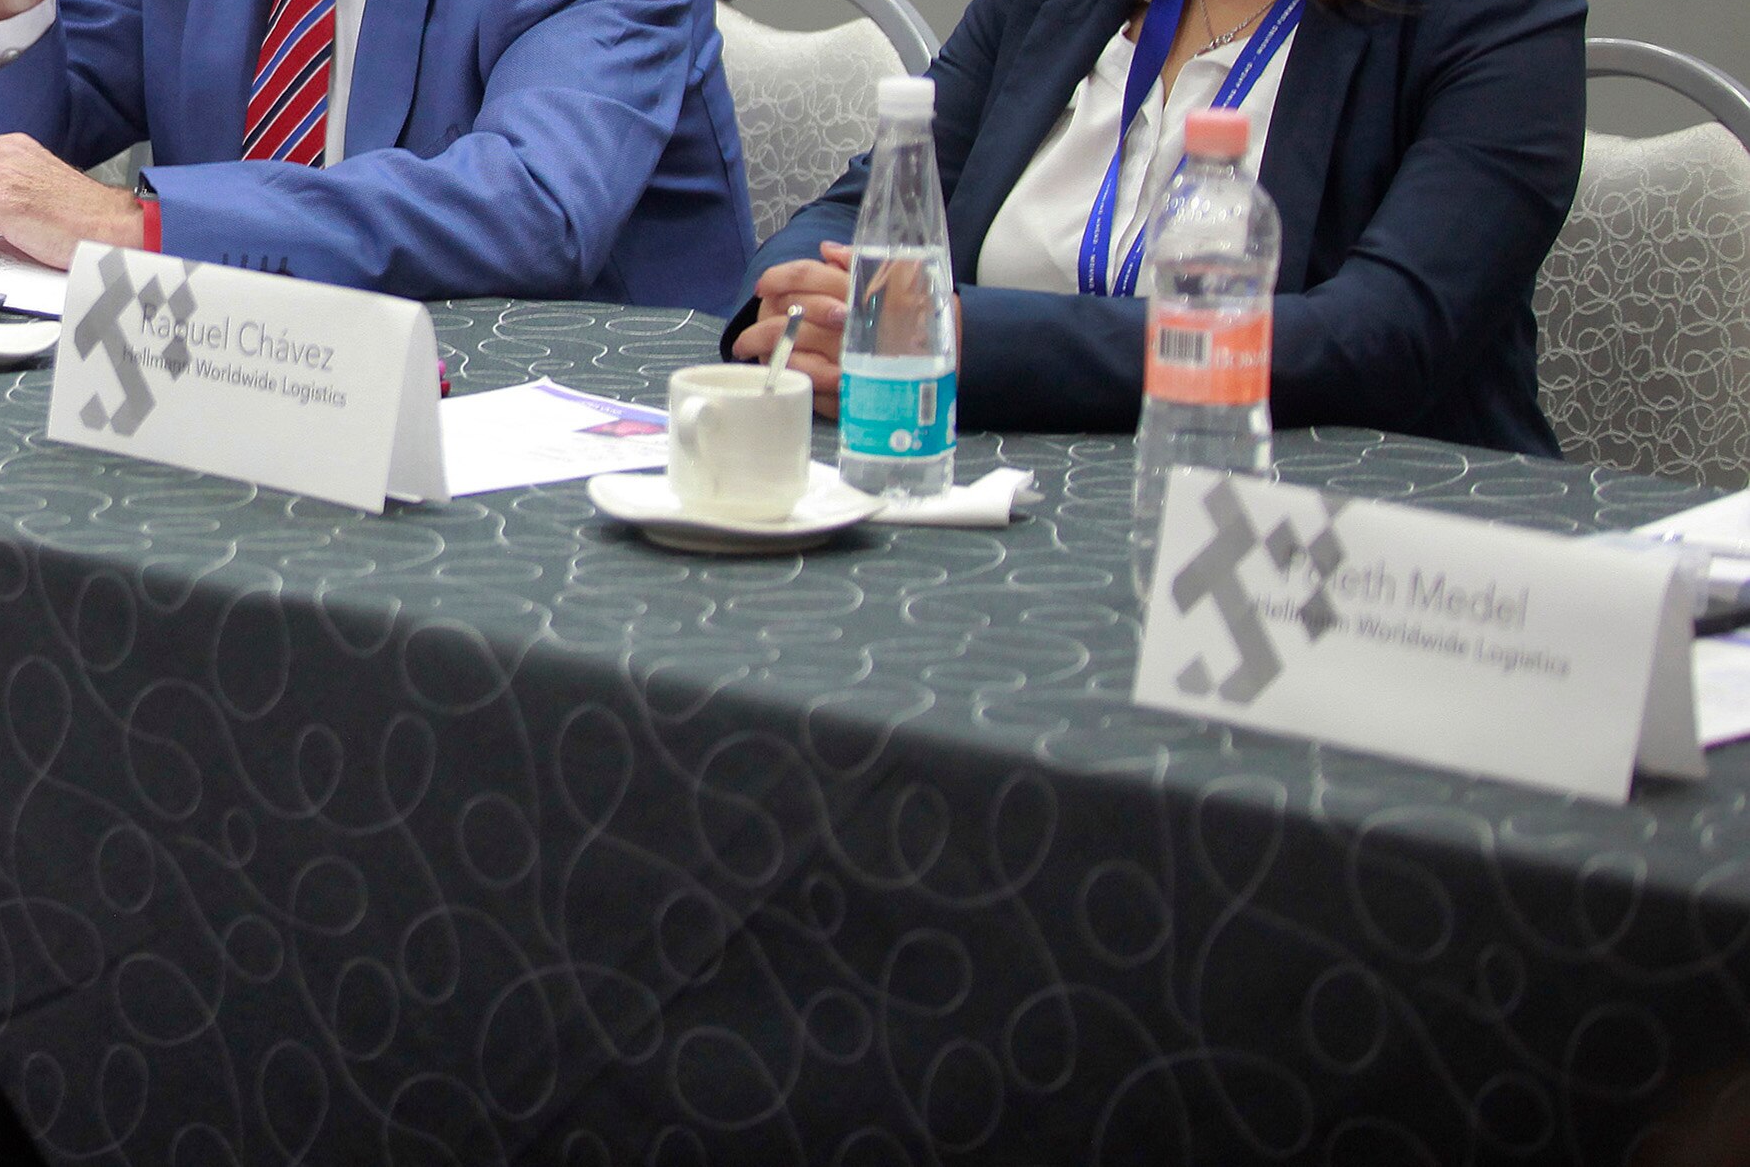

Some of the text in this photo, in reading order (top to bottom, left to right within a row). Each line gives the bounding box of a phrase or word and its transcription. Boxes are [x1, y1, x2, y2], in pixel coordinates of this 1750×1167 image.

[141, 302, 336, 372] Raquel Chávez
[195, 357, 278, 394] Worldwide
[281, 376, 349, 409] Logistics
[1407, 563, 1531, 631] Medel
[1357, 615, 1468, 656] Worldwide
[1473, 636, 1572, 678] Logistics
